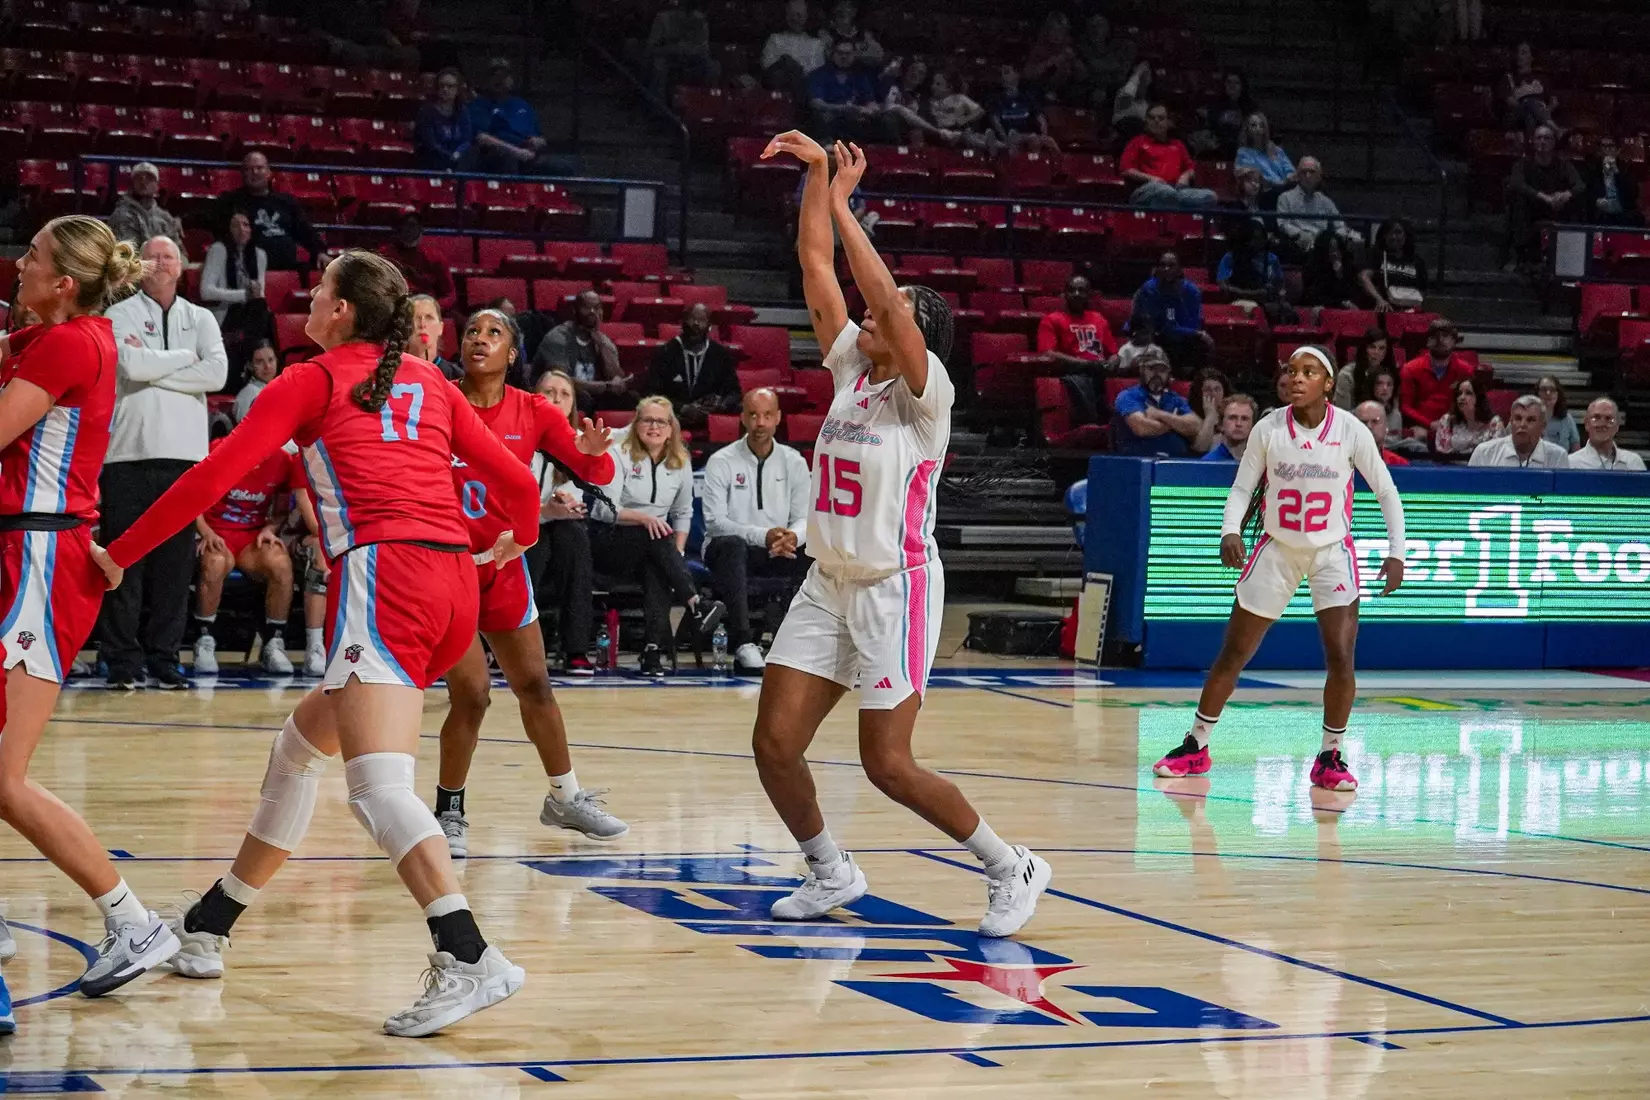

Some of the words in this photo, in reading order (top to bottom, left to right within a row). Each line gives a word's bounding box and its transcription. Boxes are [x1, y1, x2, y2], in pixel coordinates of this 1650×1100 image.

[380, 383, 424, 442] 17
[462, 480, 488, 519] 0
[815, 453, 862, 518] 15
[1277, 489, 1332, 533] 22
[1355, 538, 1466, 603] per
[1465, 505, 1529, 617] 1
